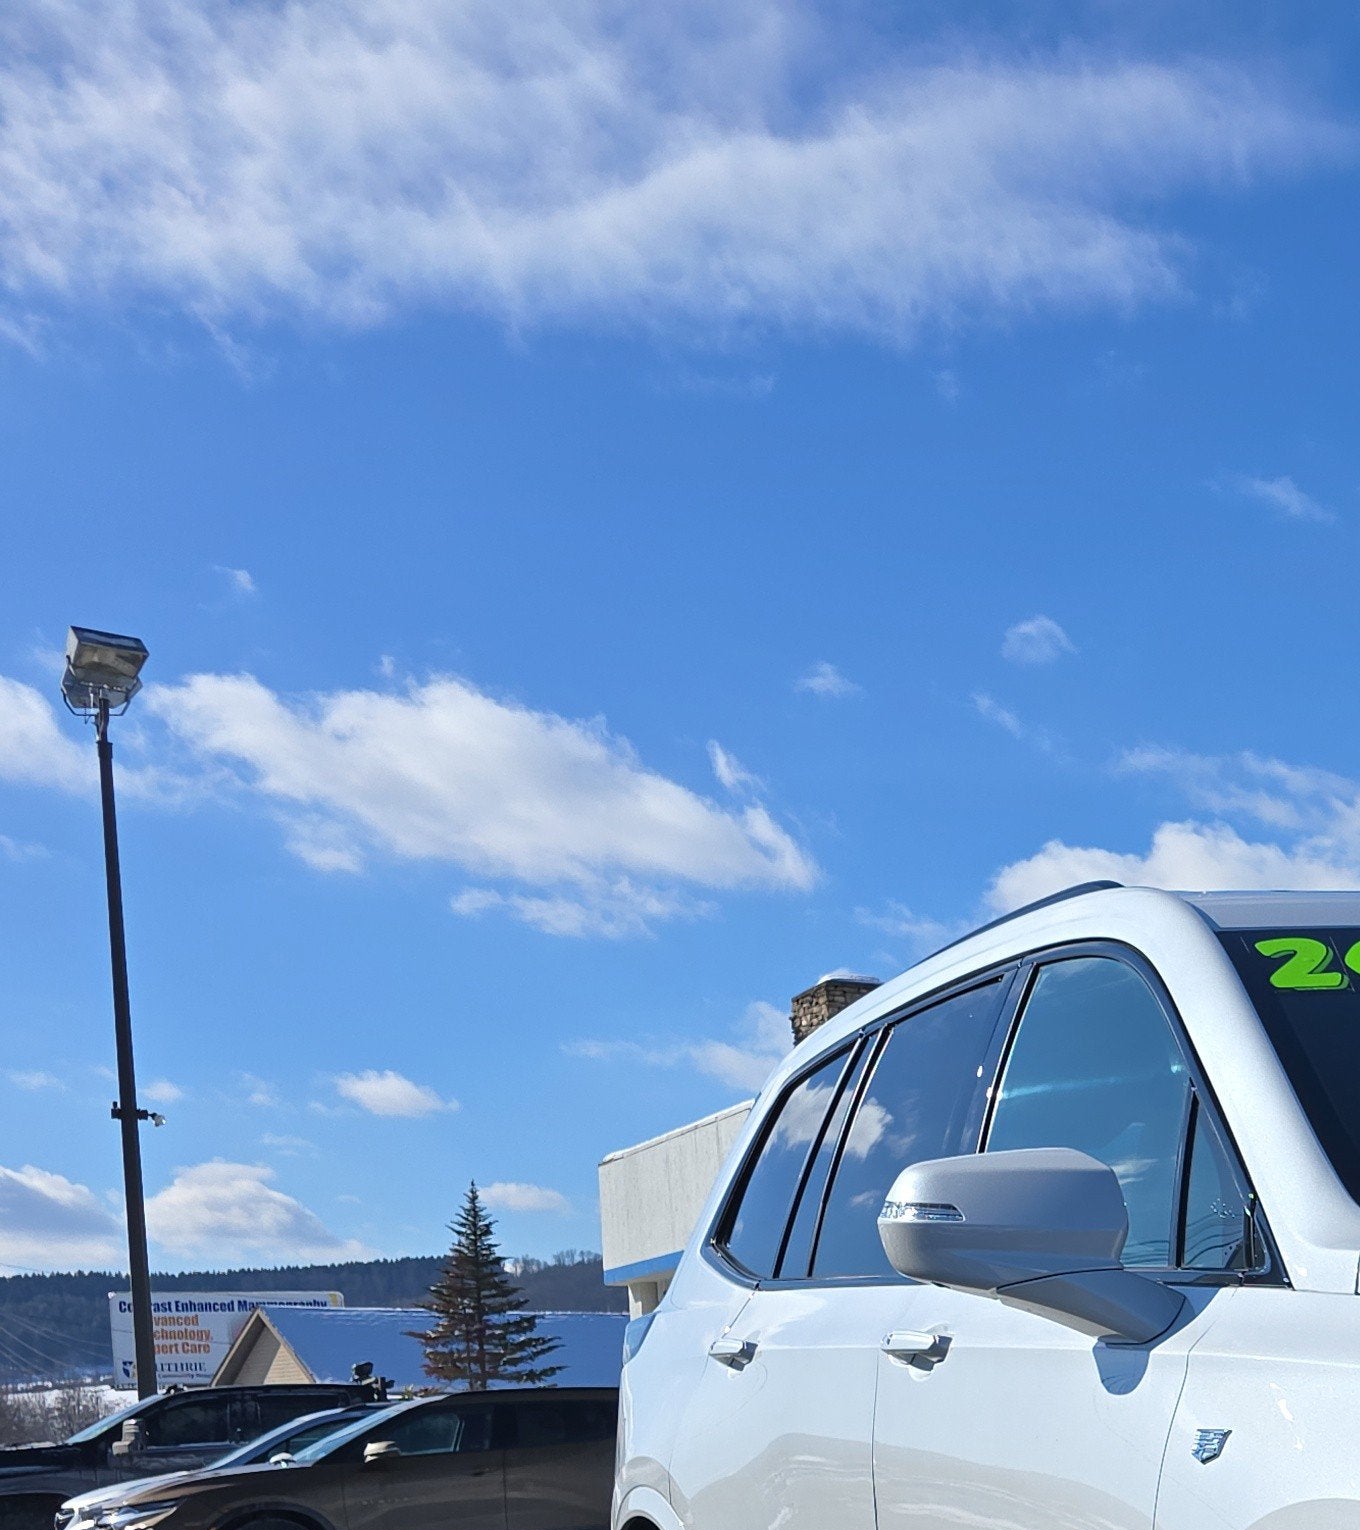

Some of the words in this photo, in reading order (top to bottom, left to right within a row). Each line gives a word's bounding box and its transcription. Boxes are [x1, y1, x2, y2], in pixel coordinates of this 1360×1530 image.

[118, 1300, 172, 1313] Coast
[175, 1300, 235, 1313] Enhanced
[153, 1314, 199, 1326] vanced
[153, 1328, 213, 1342] chnology,
[153, 1343, 179, 1354] pert
[182, 1342, 210, 1354] Care
[156, 1362, 206, 1372] THRIE
